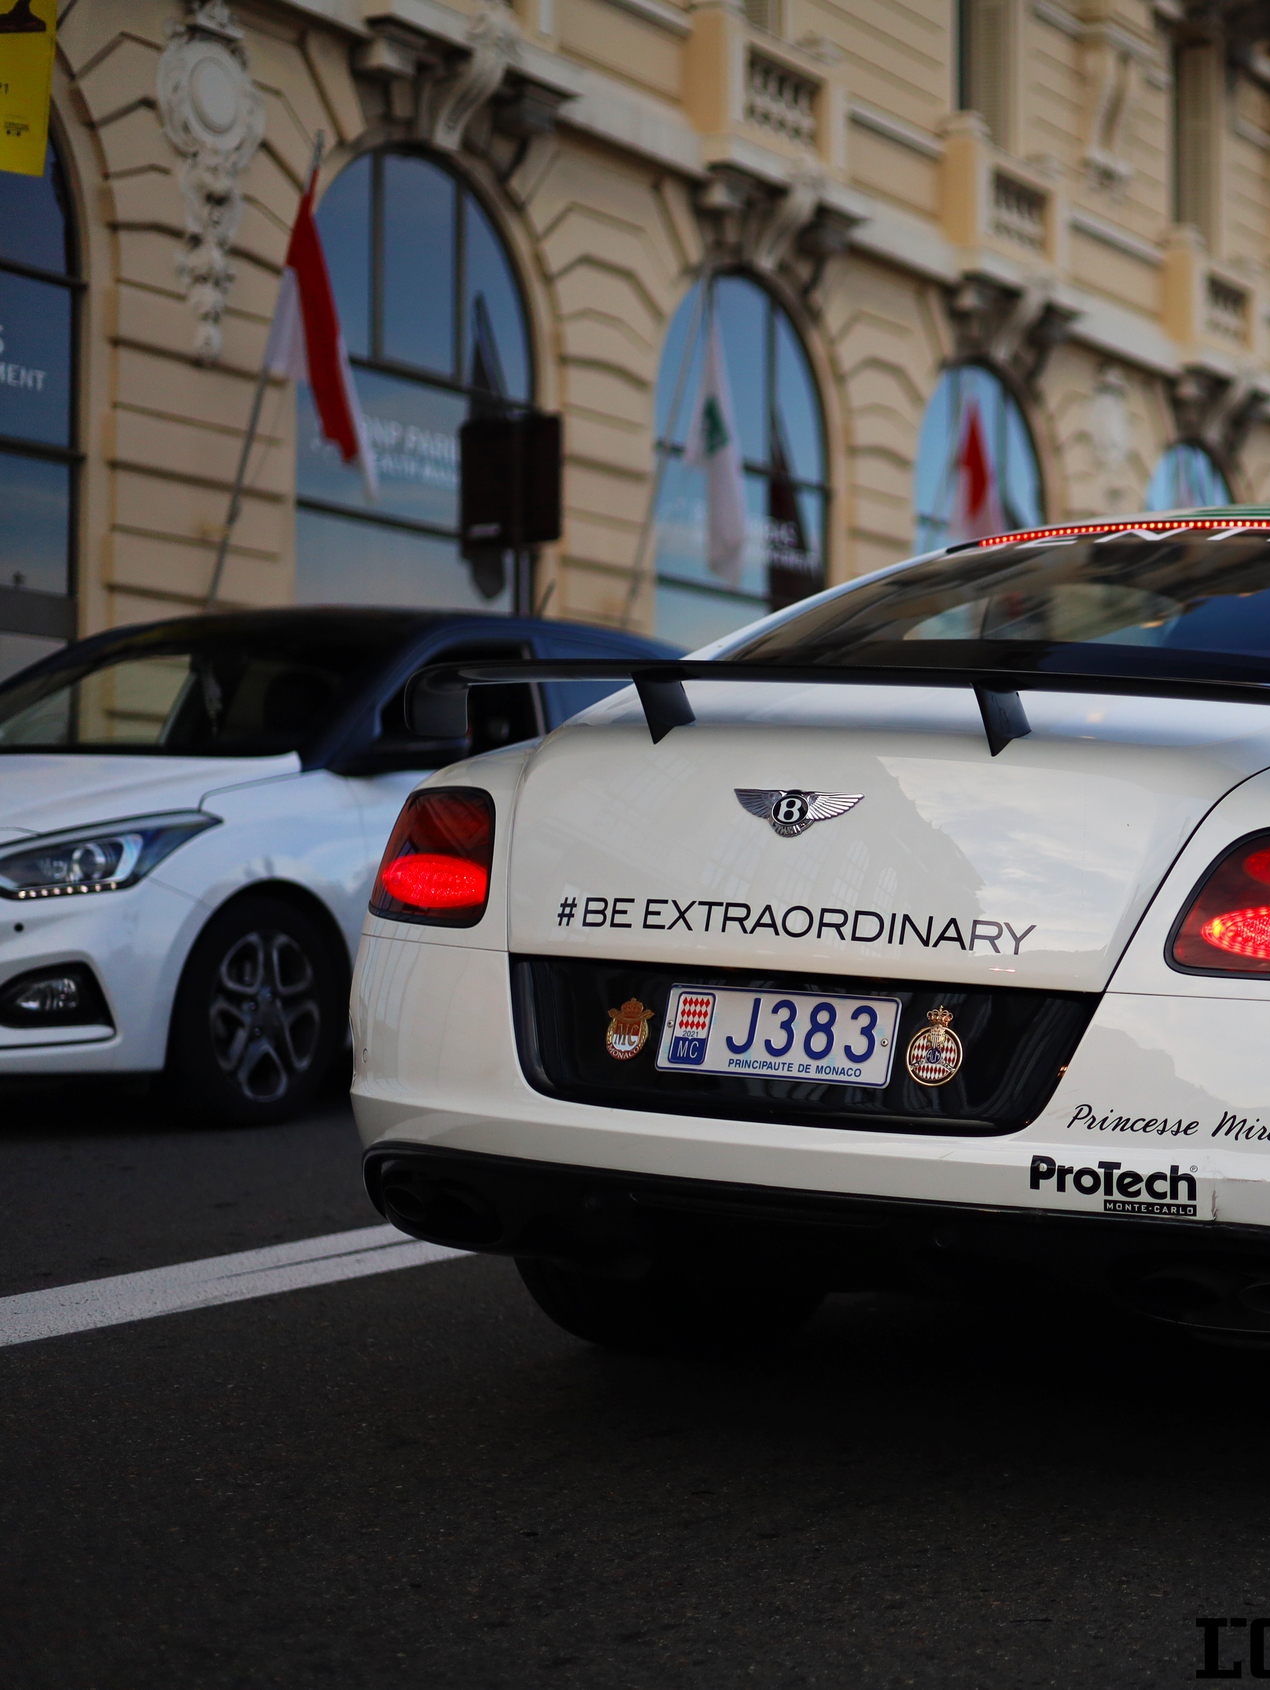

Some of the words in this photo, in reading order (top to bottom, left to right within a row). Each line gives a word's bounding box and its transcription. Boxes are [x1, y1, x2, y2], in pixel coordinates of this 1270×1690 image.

[642, 899, 1037, 955] EXTRAORDINARY
[682, 1030, 699, 1038] 2021
[726, 998, 878, 1064] J383
[607, 1043, 641, 1059] MONACO
[677, 1040, 699, 1059] MC
[728, 1059, 794, 1072] PRINCIPAUTE
[797, 1063, 811, 1074] DE
[815, 1065, 862, 1078] MONACO
[1067, 1104, 1199, 1136] Princesse
[1029, 1155, 1197, 1201] ProTech
[1106, 1202, 1194, 1215] MONTE-CARLO
